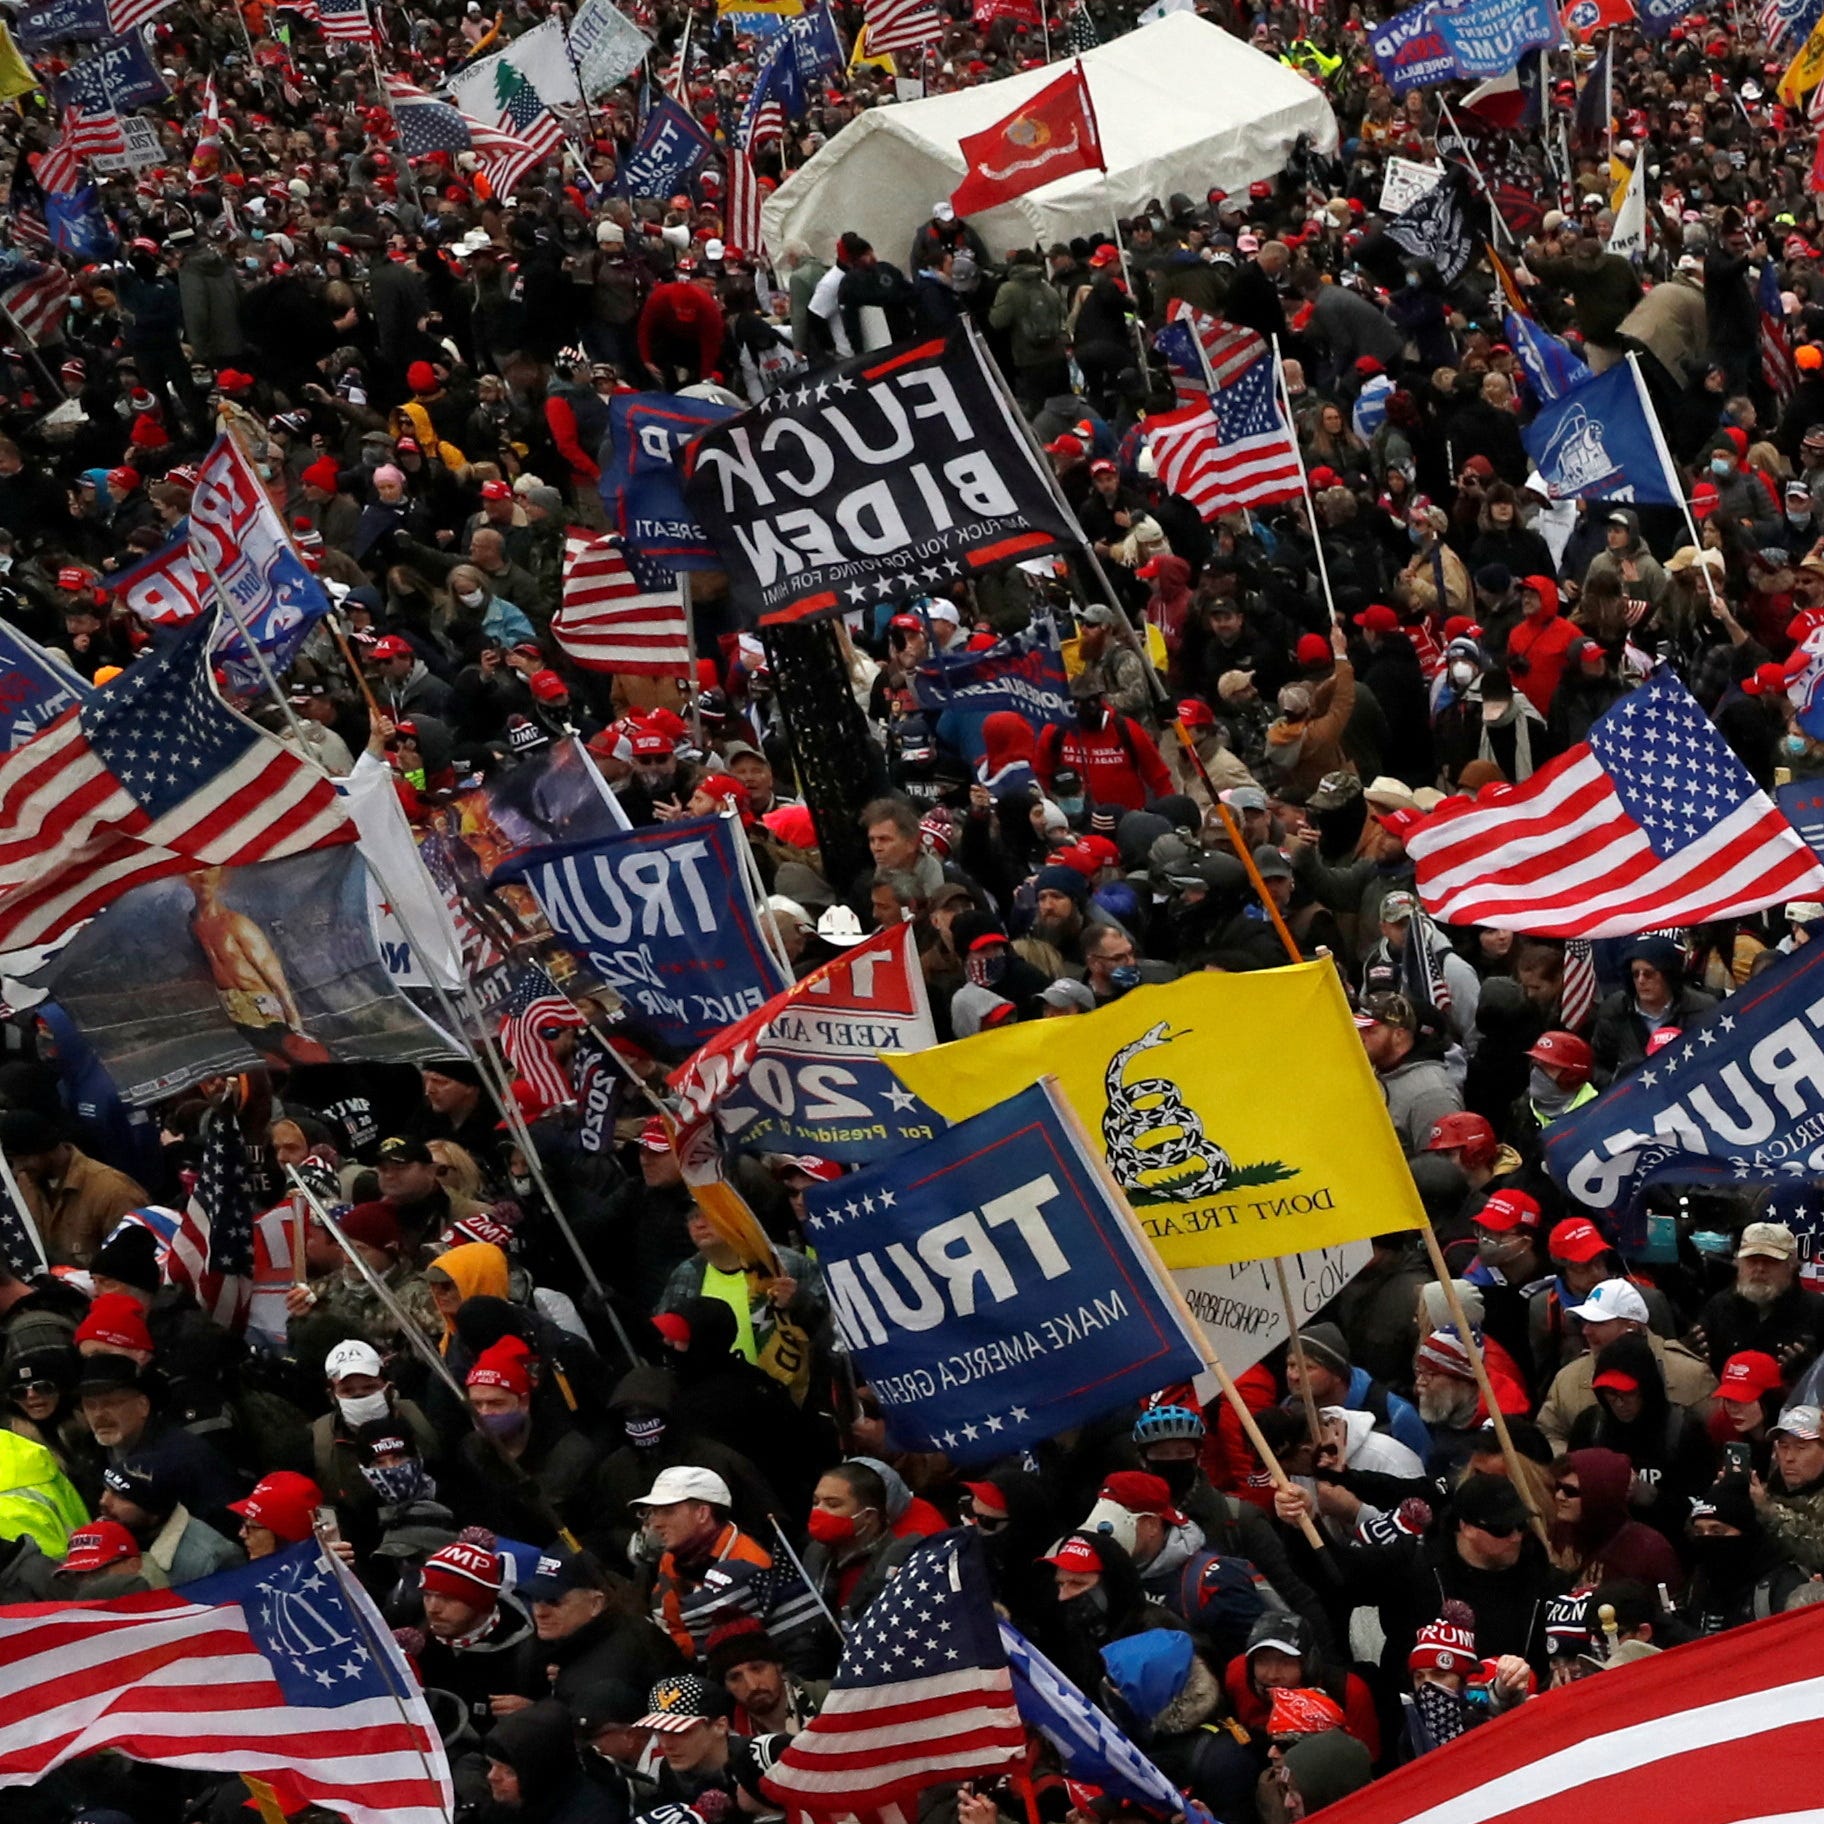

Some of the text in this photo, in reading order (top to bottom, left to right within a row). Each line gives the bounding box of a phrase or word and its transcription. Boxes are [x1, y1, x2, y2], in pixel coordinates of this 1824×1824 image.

[1094, 756, 1124, 766] AGAIN
[1301, 1256, 1352, 1314] GOV.
[1184, 1286, 1281, 1340] BARBERSHOP?
[371, 1440, 405, 1454] TRUMP
